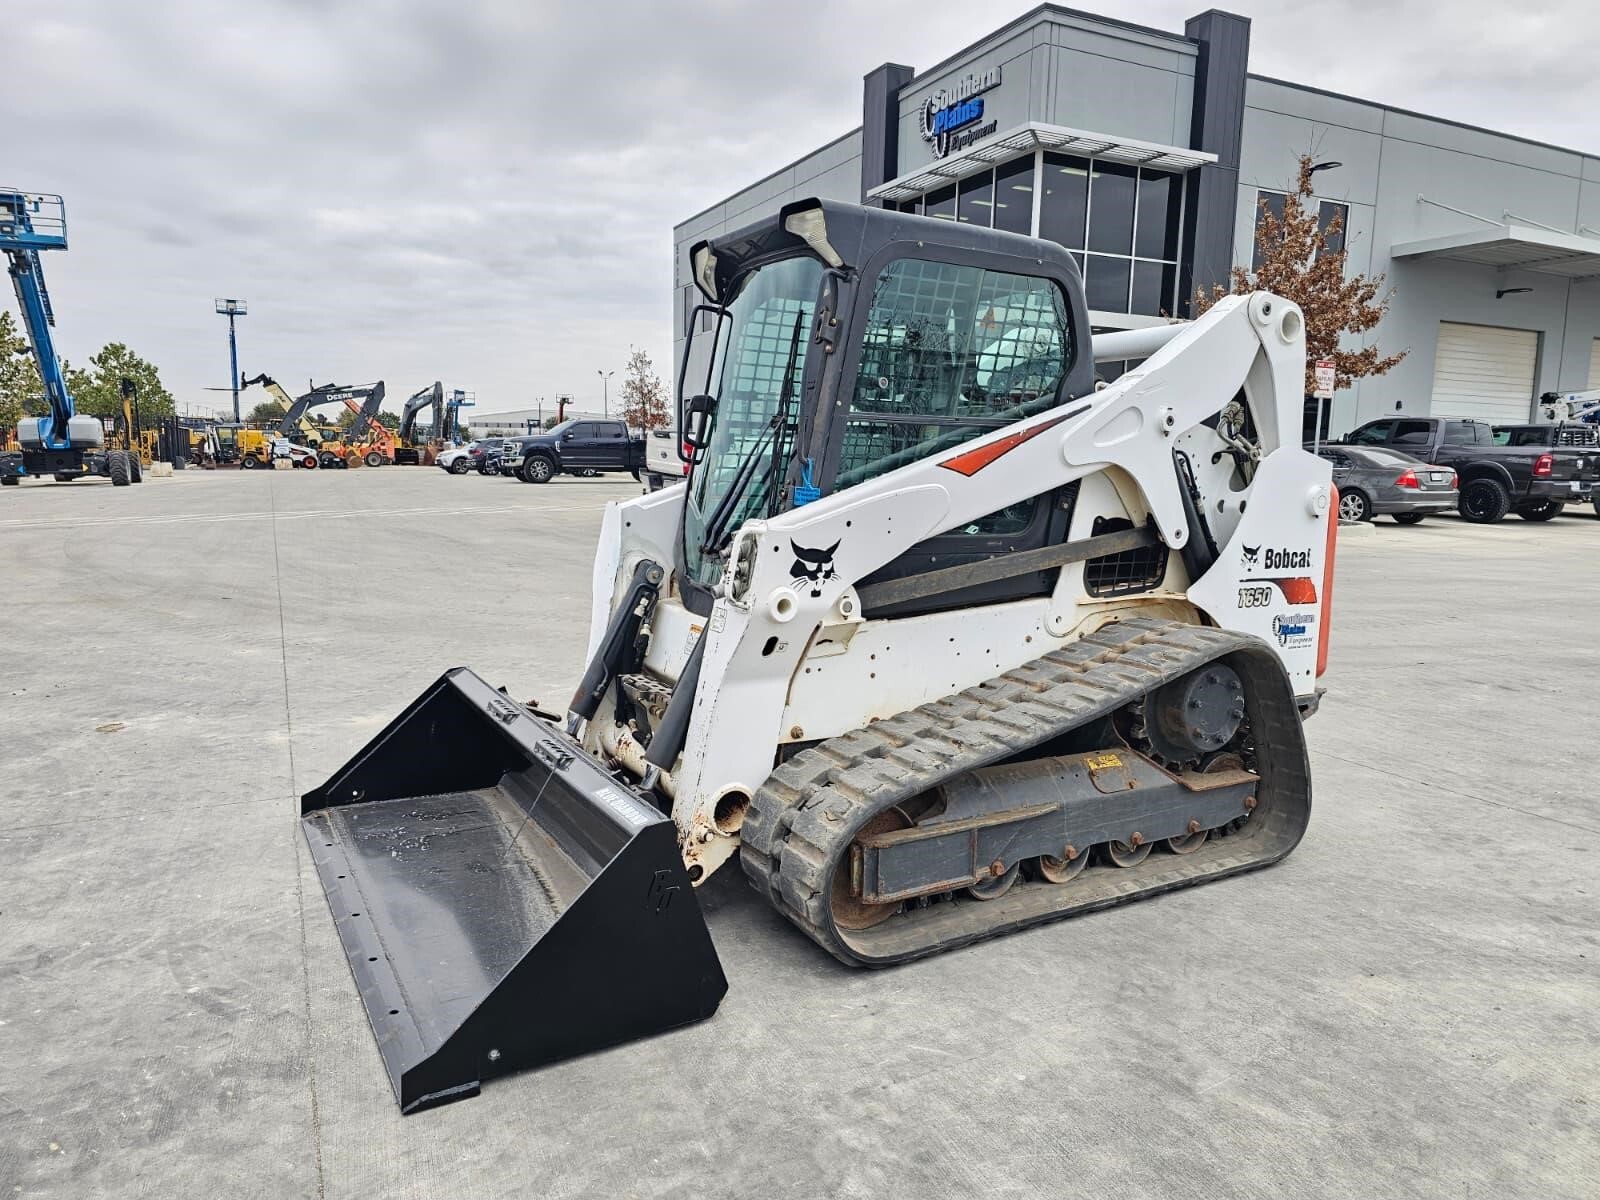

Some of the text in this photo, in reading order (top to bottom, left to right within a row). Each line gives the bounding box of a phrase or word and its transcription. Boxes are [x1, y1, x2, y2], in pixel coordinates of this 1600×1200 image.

[931, 66, 1002, 115] Southern
[933, 98, 984, 136] Plains
[950, 119, 998, 151] Equipment
[326, 392, 353, 401] DEERE
[1264, 547, 1311, 569] Bobcat
[1238, 586, 1273, 609] T650
